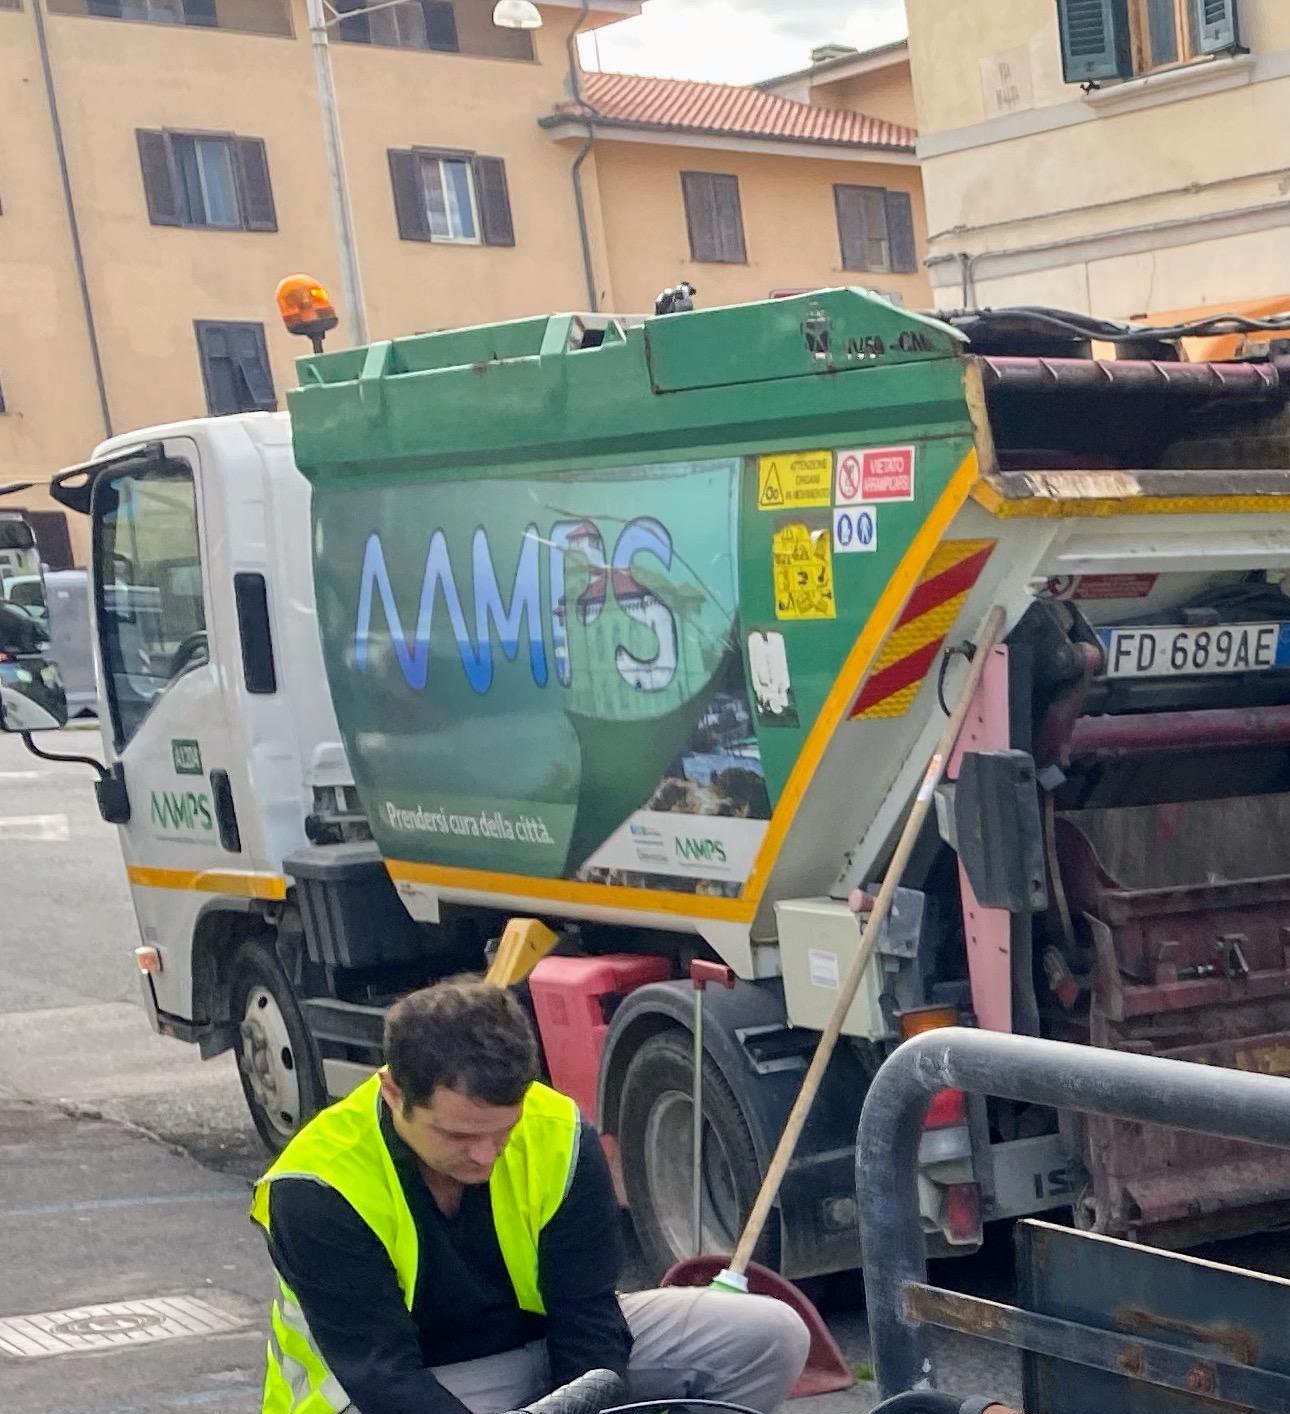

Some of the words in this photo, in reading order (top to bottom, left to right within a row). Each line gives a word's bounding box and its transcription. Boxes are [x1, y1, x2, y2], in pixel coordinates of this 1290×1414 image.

[869, 457, 904, 474] VIETATO
[1113, 632, 1157, 673] FD
[1169, 629, 1275, 670] 689AE
[386, 801, 447, 834] Prendersi
[449, 814, 480, 836] cura
[481, 811, 514, 841] della
